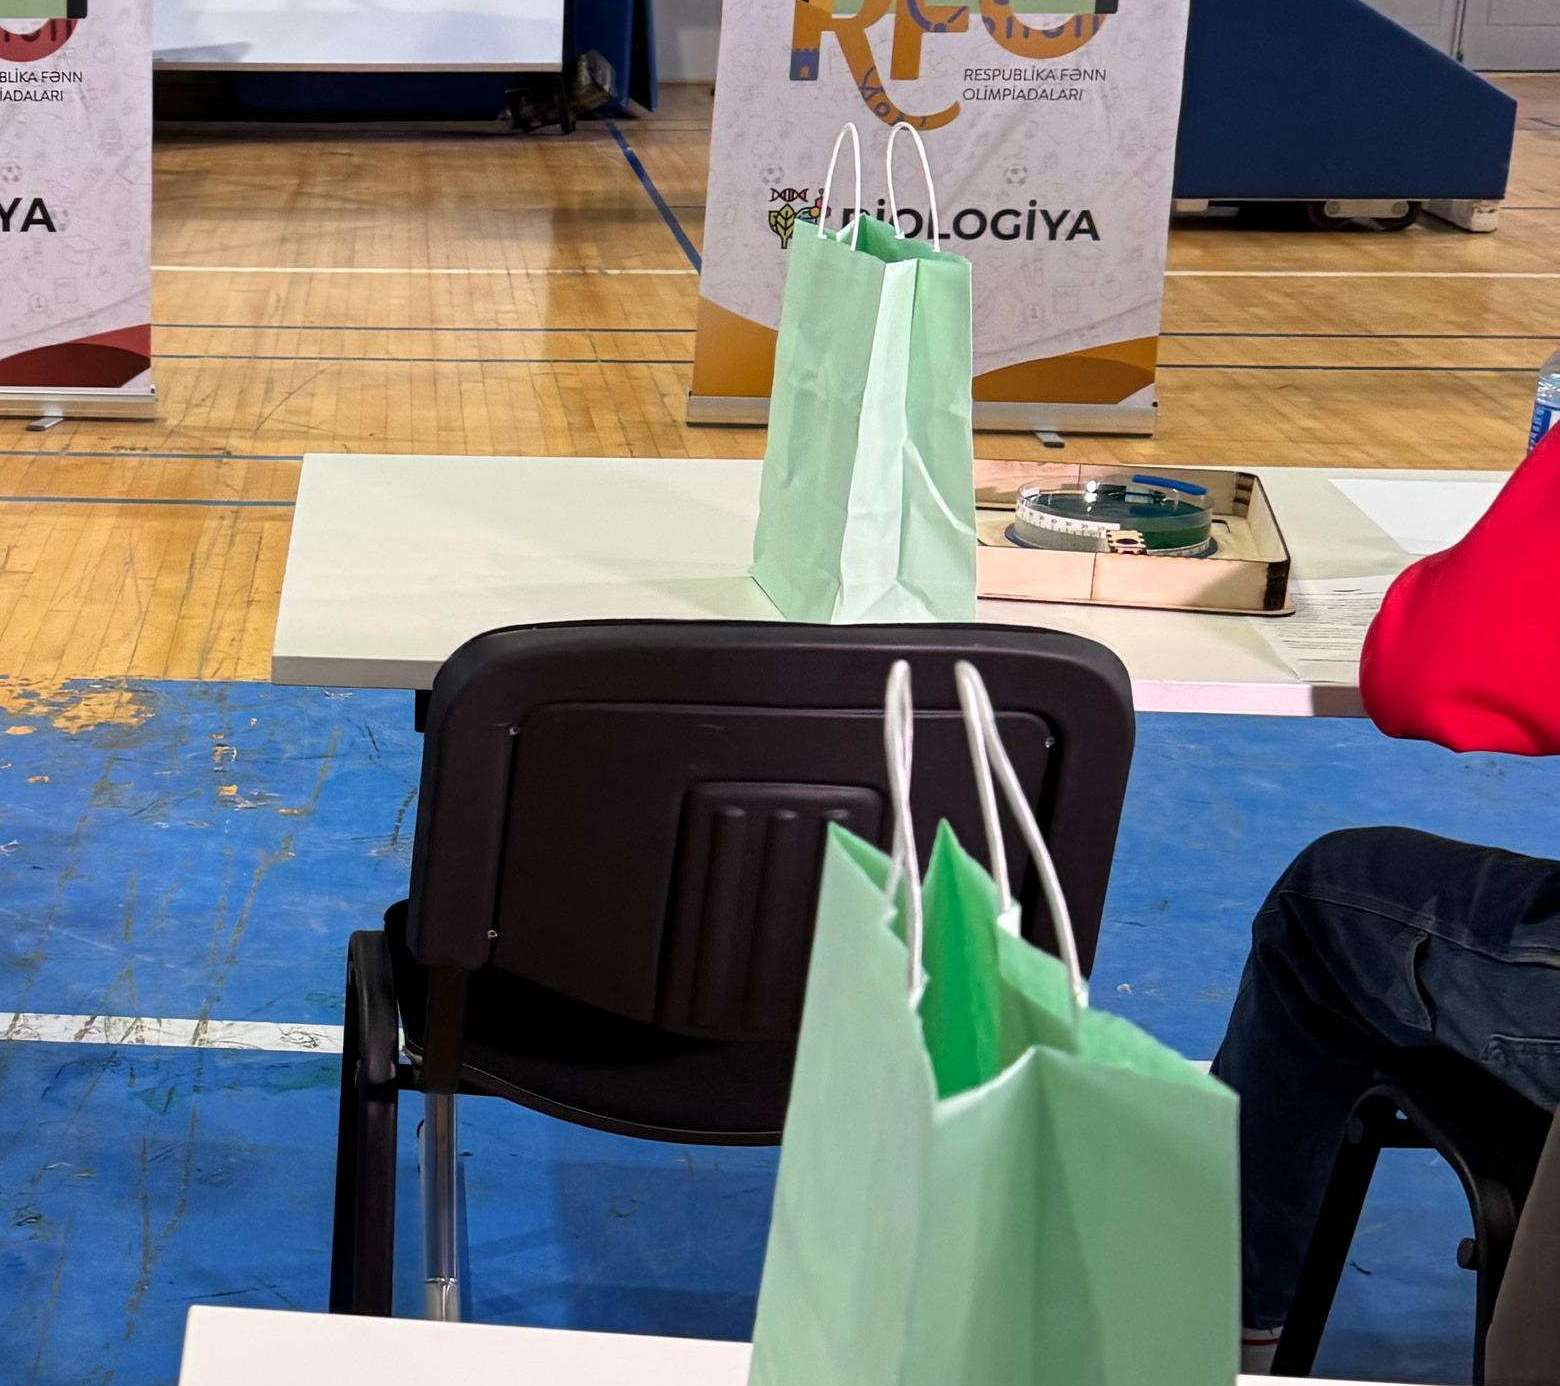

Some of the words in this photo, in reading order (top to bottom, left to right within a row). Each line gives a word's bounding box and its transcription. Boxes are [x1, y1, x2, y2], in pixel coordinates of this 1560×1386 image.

[41, 71, 83, 83] FƏNN
[963, 65, 1057, 82] RESPUBLİKA
[1059, 68, 1107, 82] FƏNN
[962, 85, 1084, 101] OLİMPİADALARI
